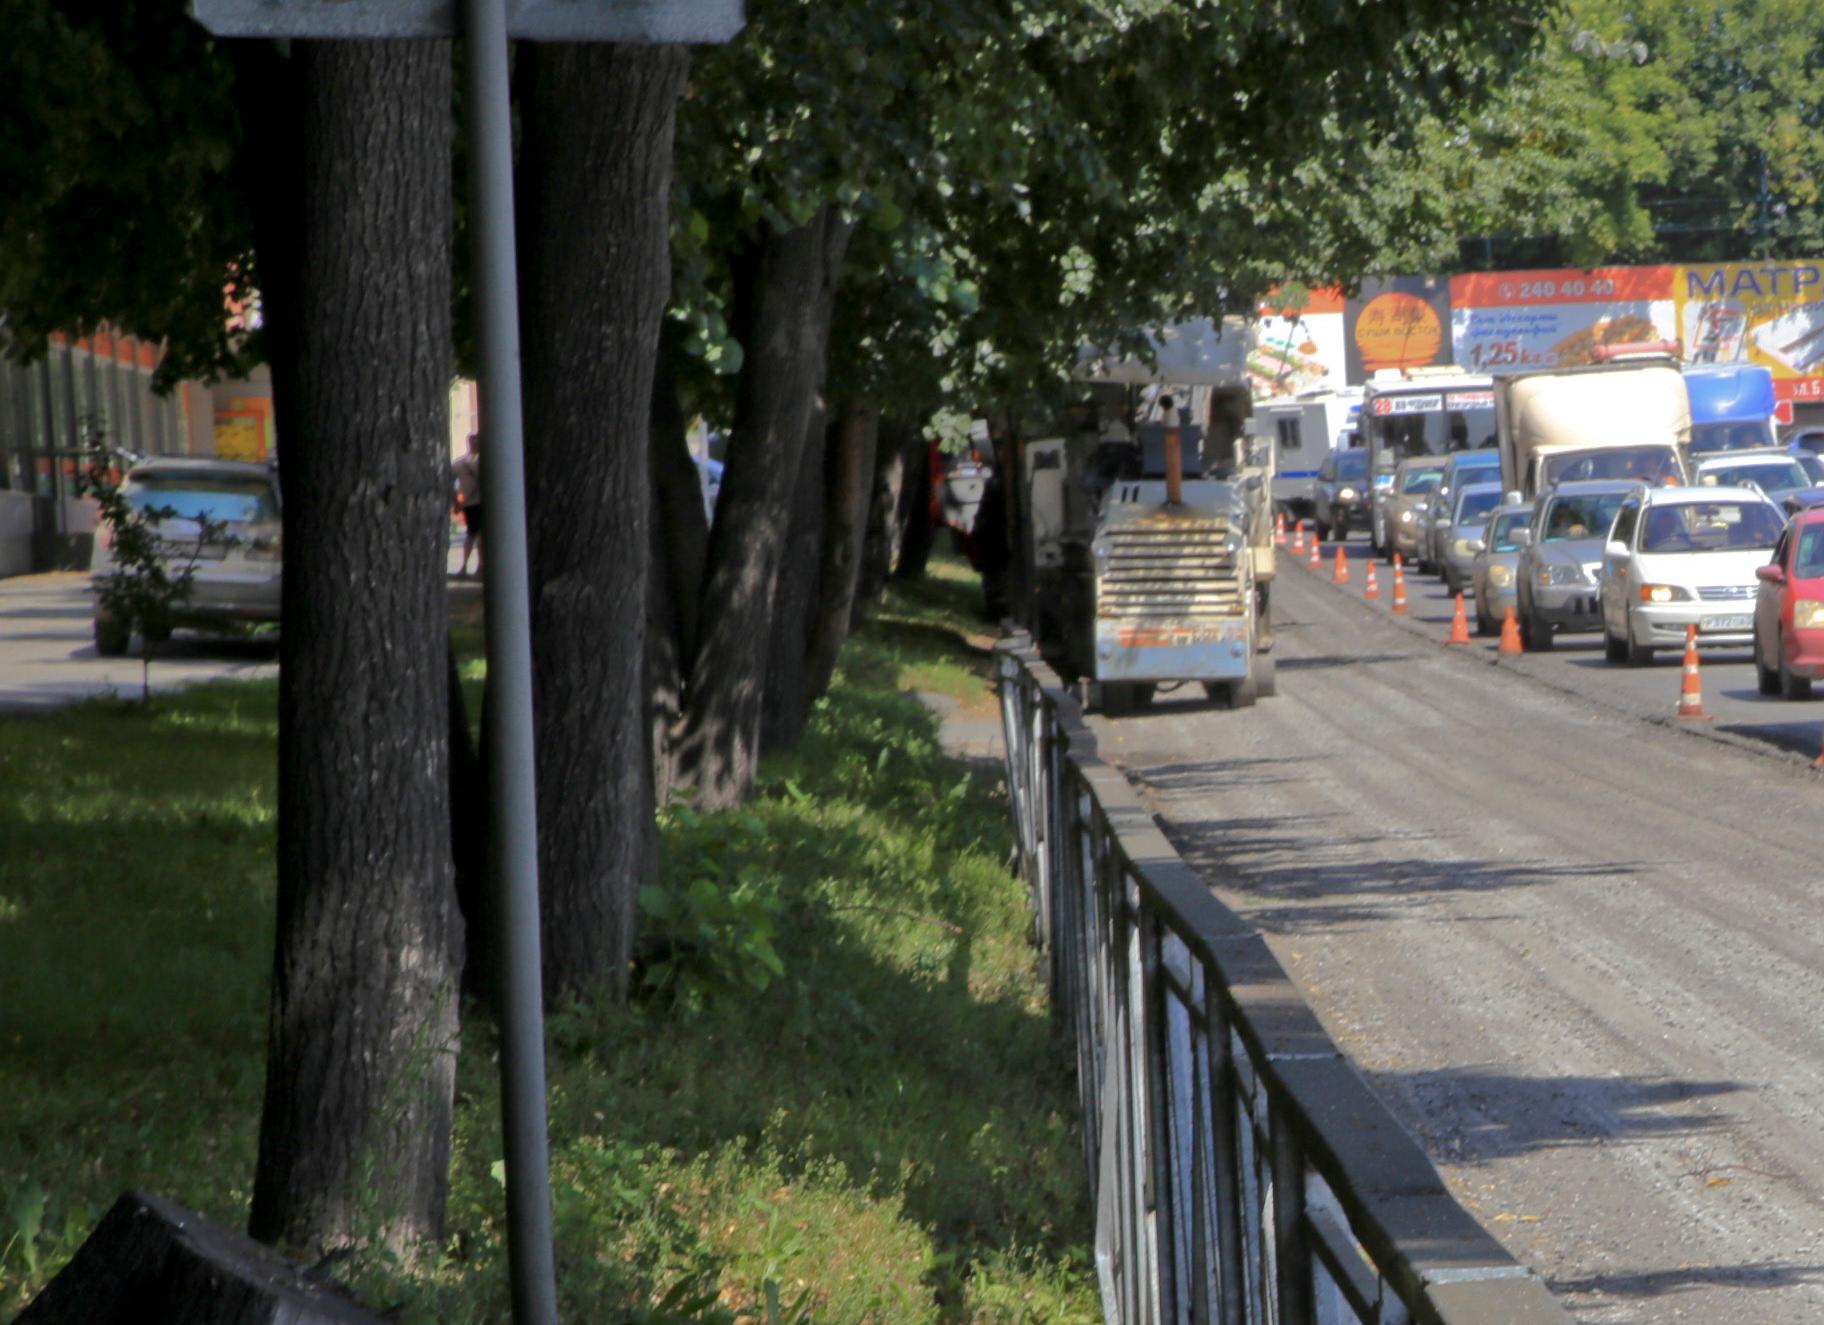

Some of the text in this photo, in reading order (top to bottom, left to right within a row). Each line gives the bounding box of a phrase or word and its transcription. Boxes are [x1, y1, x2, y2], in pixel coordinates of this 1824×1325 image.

[1519, 278, 1615, 298] 240 40 40
[1357, 325, 1439, 338] СУШИ ВОСТОК
